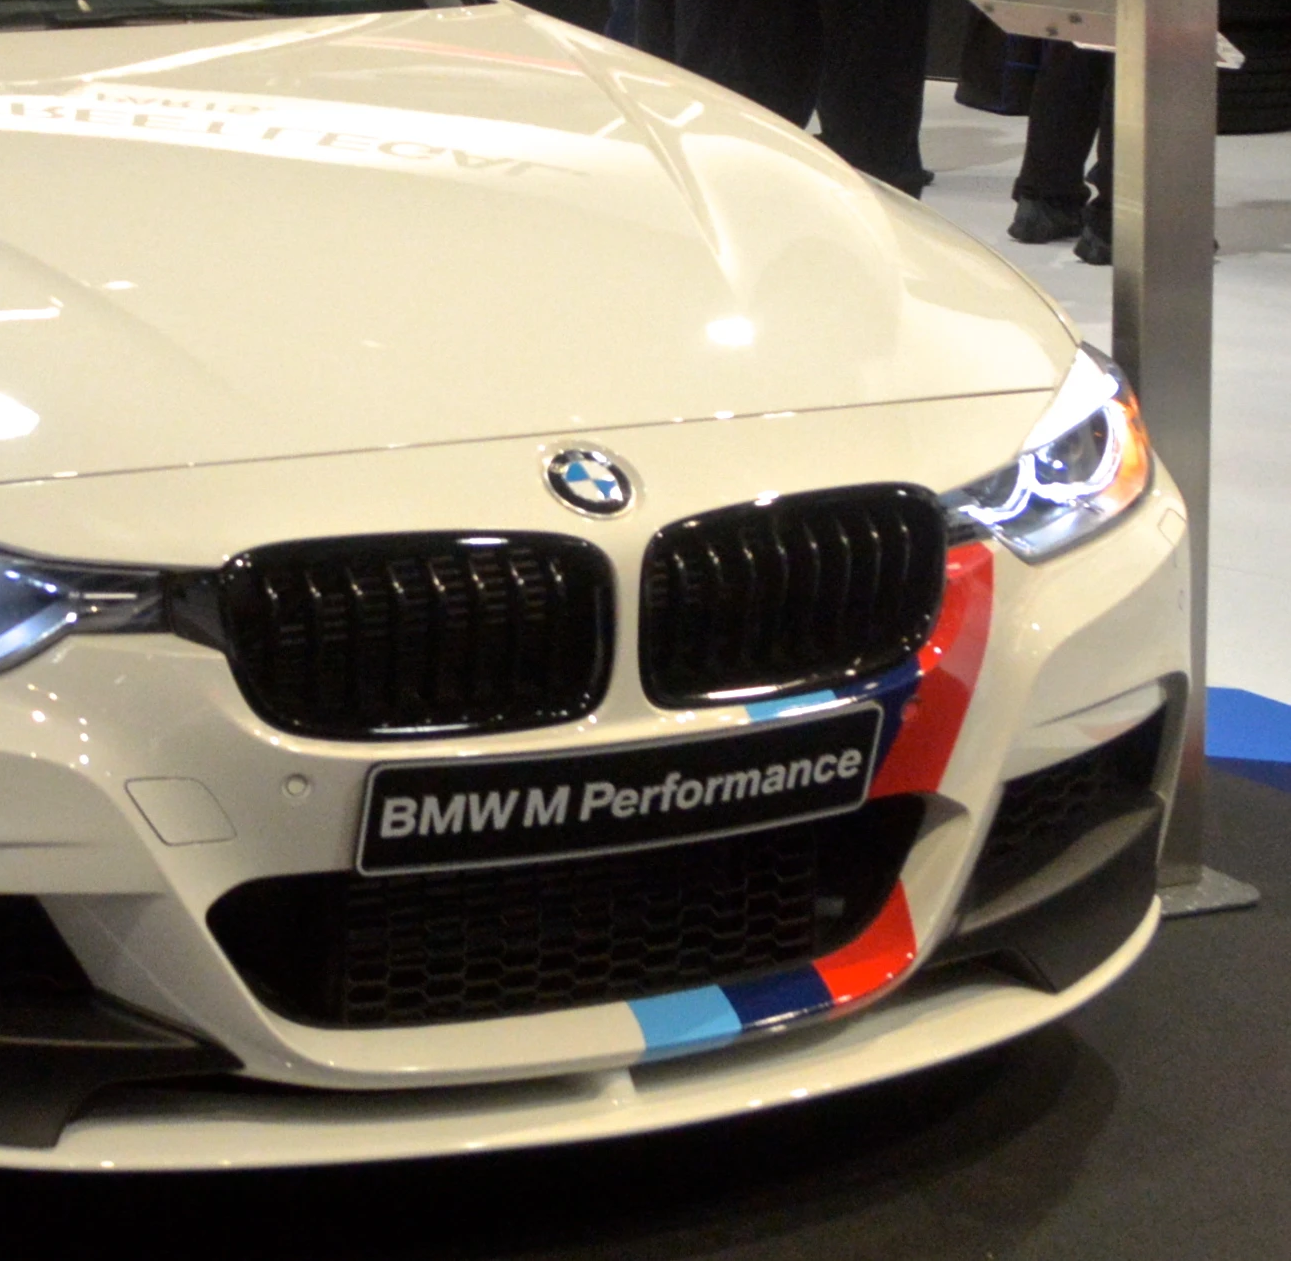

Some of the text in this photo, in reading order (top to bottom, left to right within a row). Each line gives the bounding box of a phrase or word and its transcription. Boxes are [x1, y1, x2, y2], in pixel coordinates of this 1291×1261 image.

[380, 748, 863, 838] BMW M Performance
